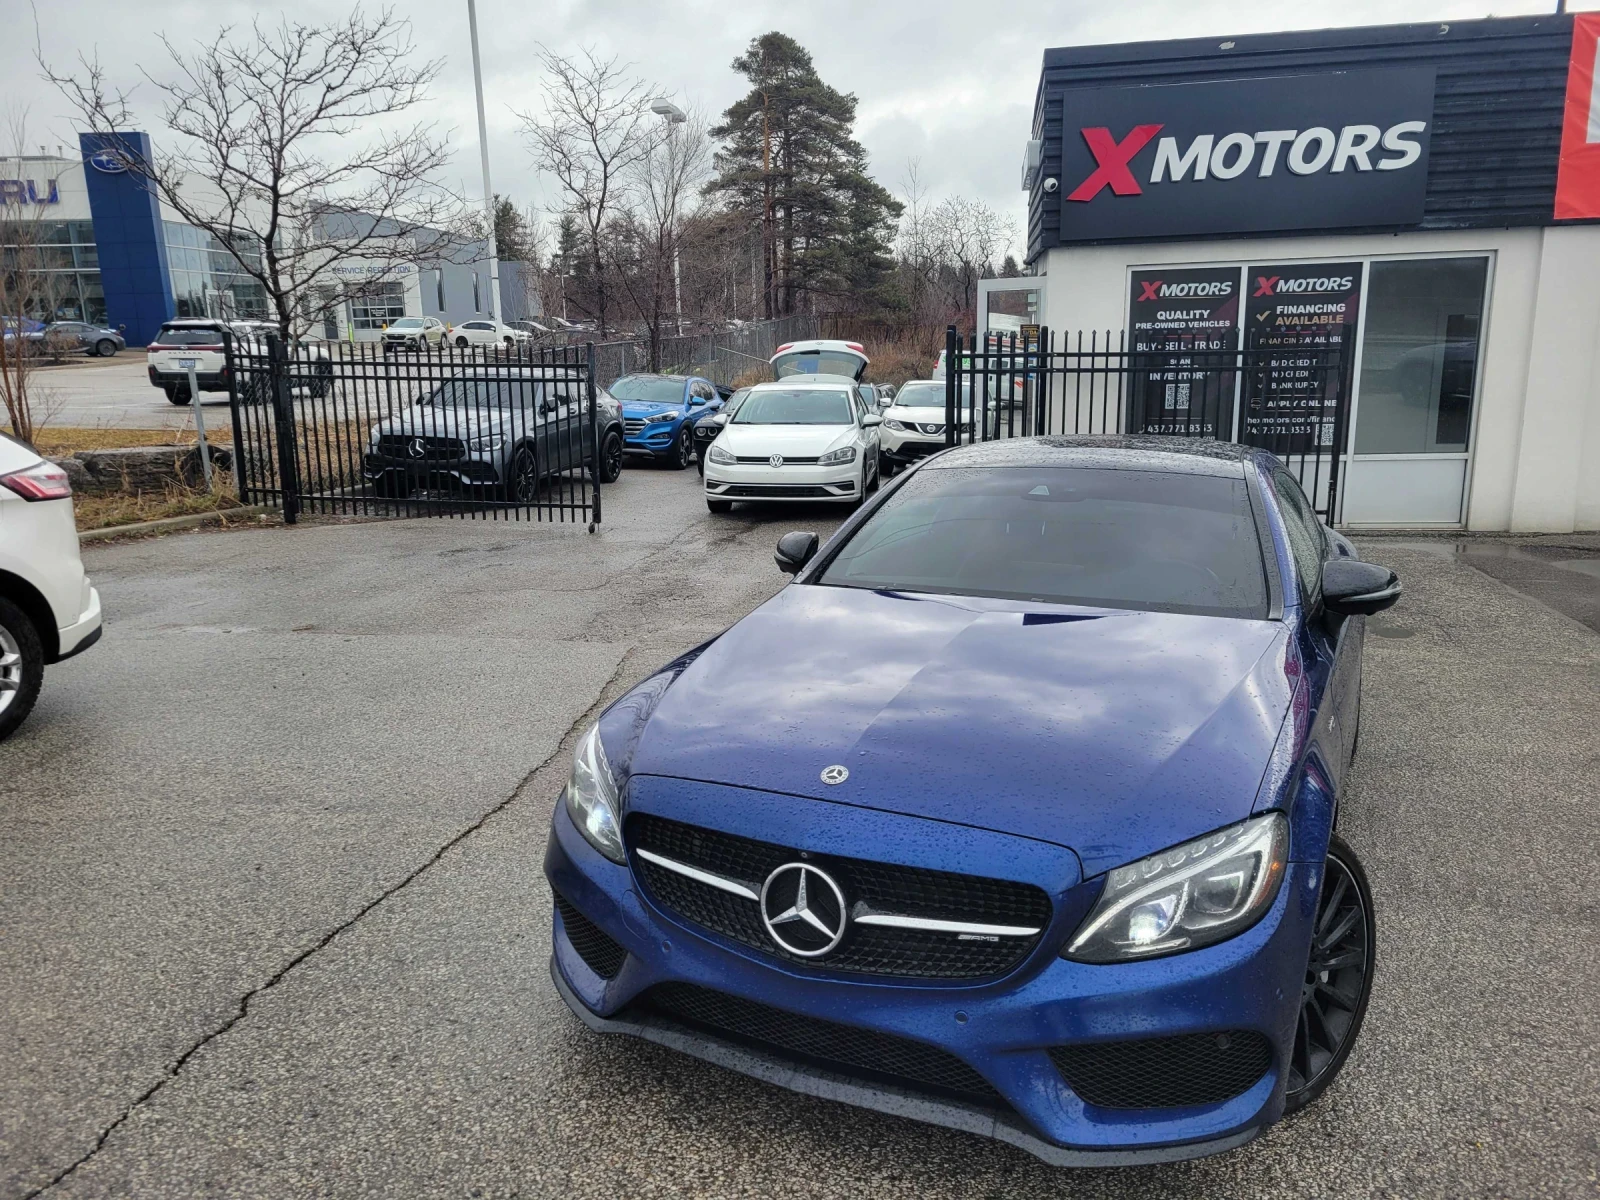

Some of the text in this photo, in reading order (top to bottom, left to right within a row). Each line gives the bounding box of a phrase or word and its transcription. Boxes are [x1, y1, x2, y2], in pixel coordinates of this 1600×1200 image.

[367, 265, 411, 274] RECETION
[1276, 303, 1346, 314] FINANCING
[1156, 309, 1211, 320] QUALITY
[1275, 314, 1344, 326] AVAILABLE
[1135, 320, 1231, 330] PRE-OWNED VEHICLES
[1136, 342, 1157, 351] BUY
[1288, 358, 1318, 367] CREDT
[1285, 370, 1315, 378] CREDI
[1300, 399, 1337, 407] ONLNE
